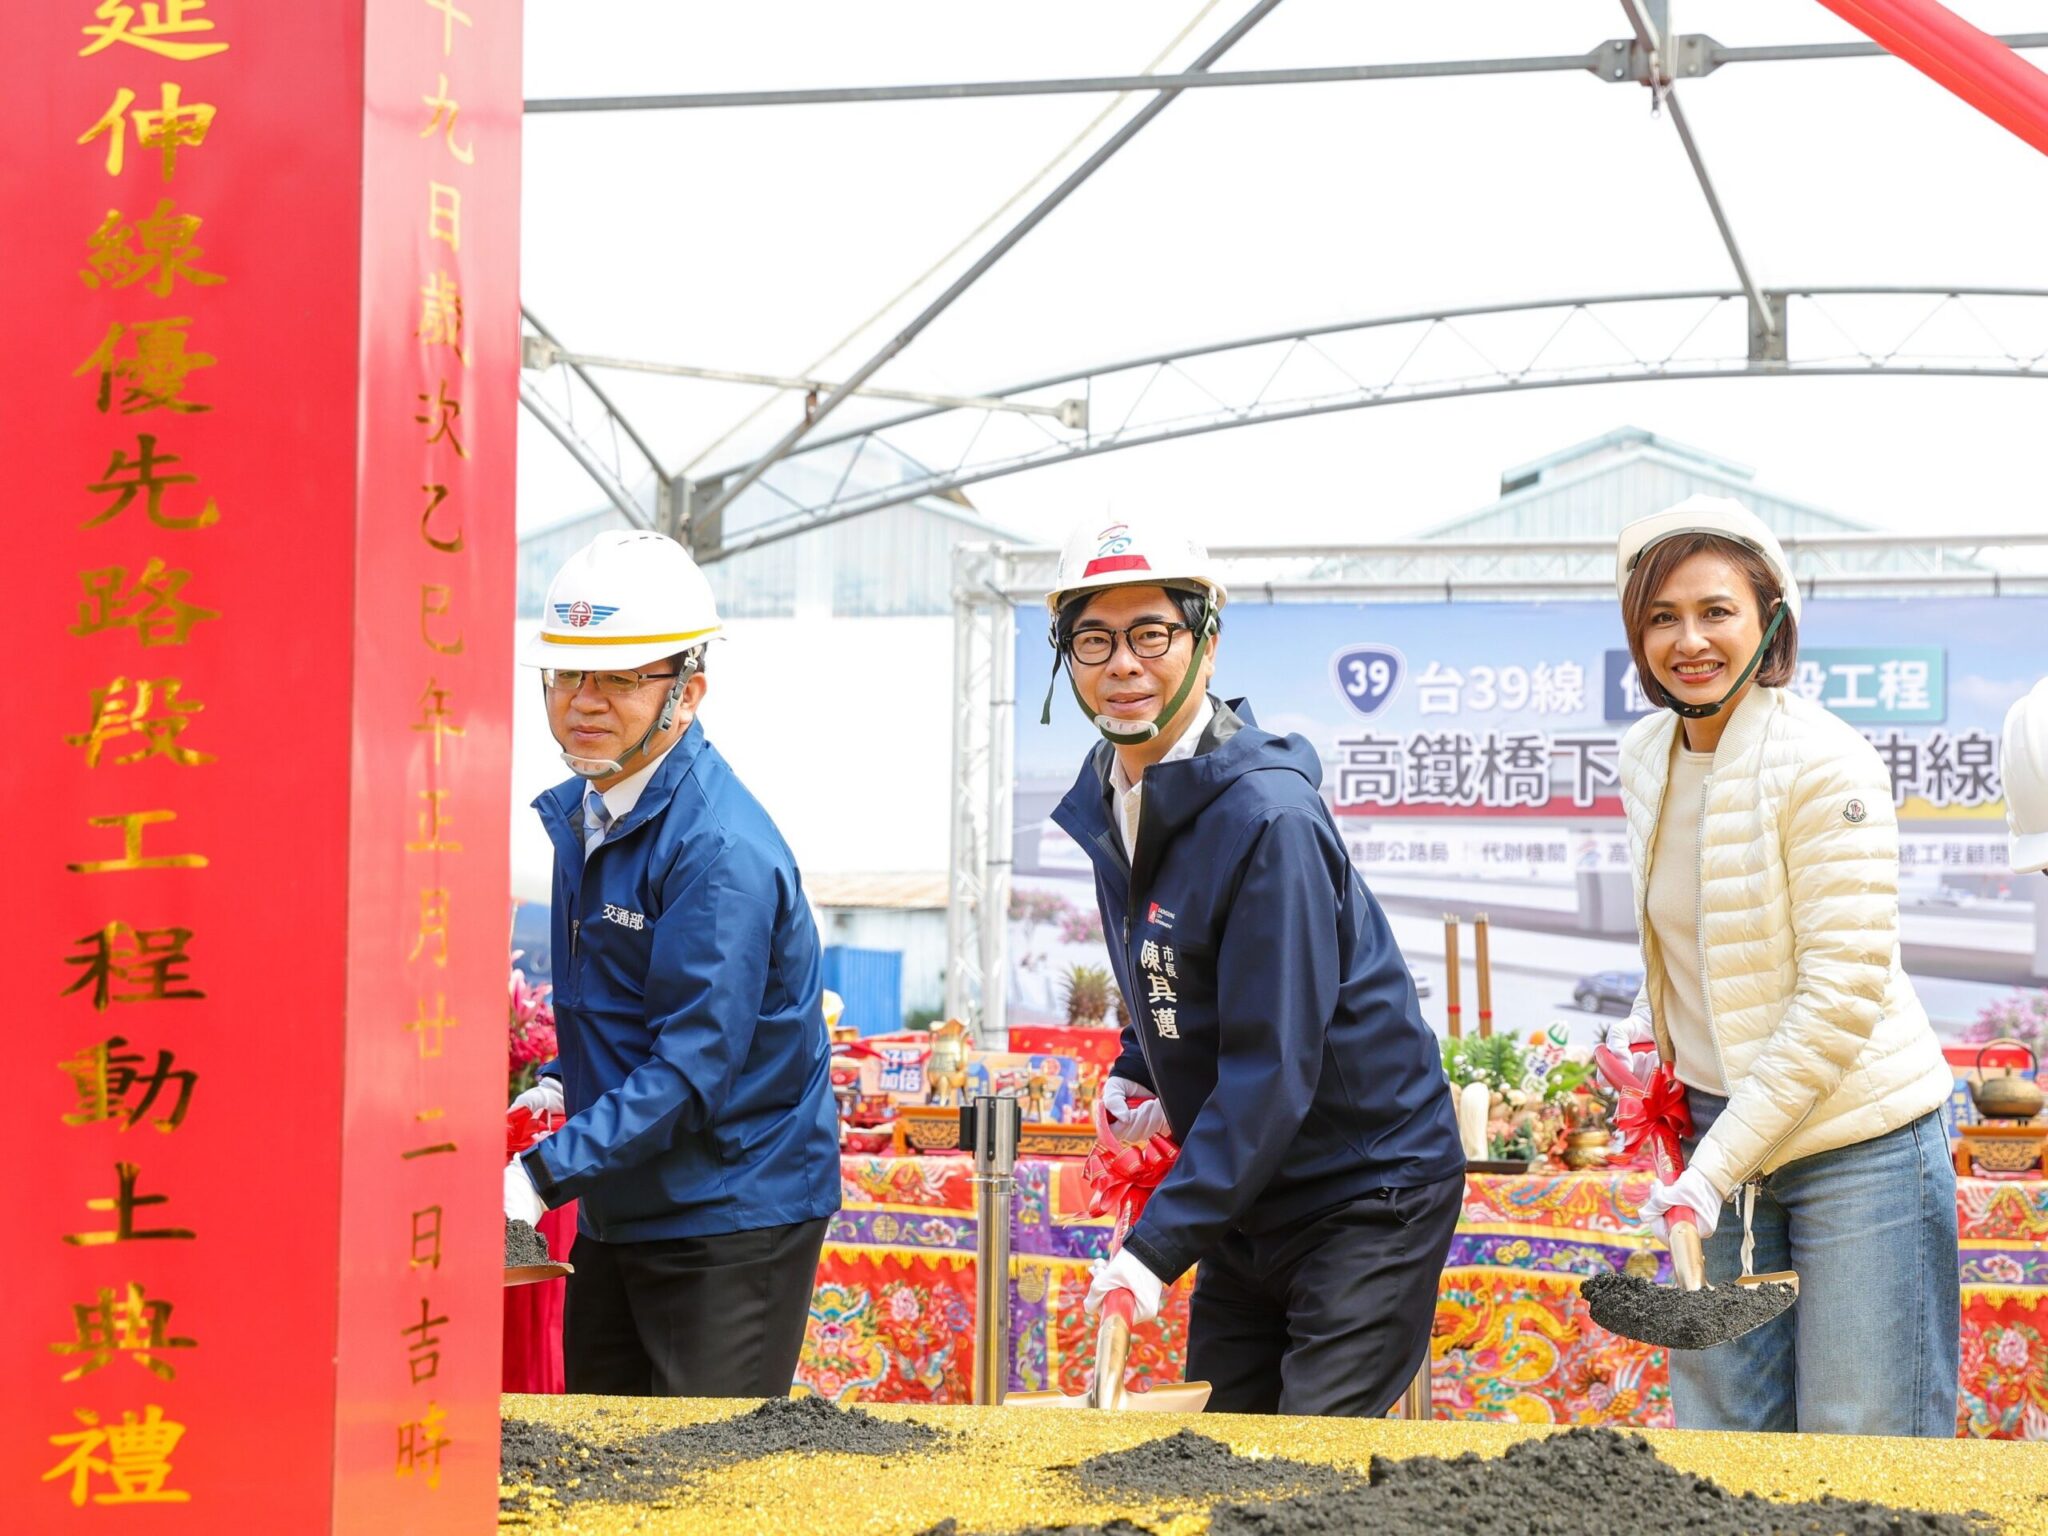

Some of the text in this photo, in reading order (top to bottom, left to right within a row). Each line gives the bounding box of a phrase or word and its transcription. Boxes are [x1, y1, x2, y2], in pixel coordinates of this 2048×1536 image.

[1347, 659, 1391, 697] 39
[1416, 660, 1586, 715] 台39線
[601, 903, 646, 931] 交通部
[1161, 945, 1180, 980] 市長
[1140, 938, 1181, 1040] 陳其邁
